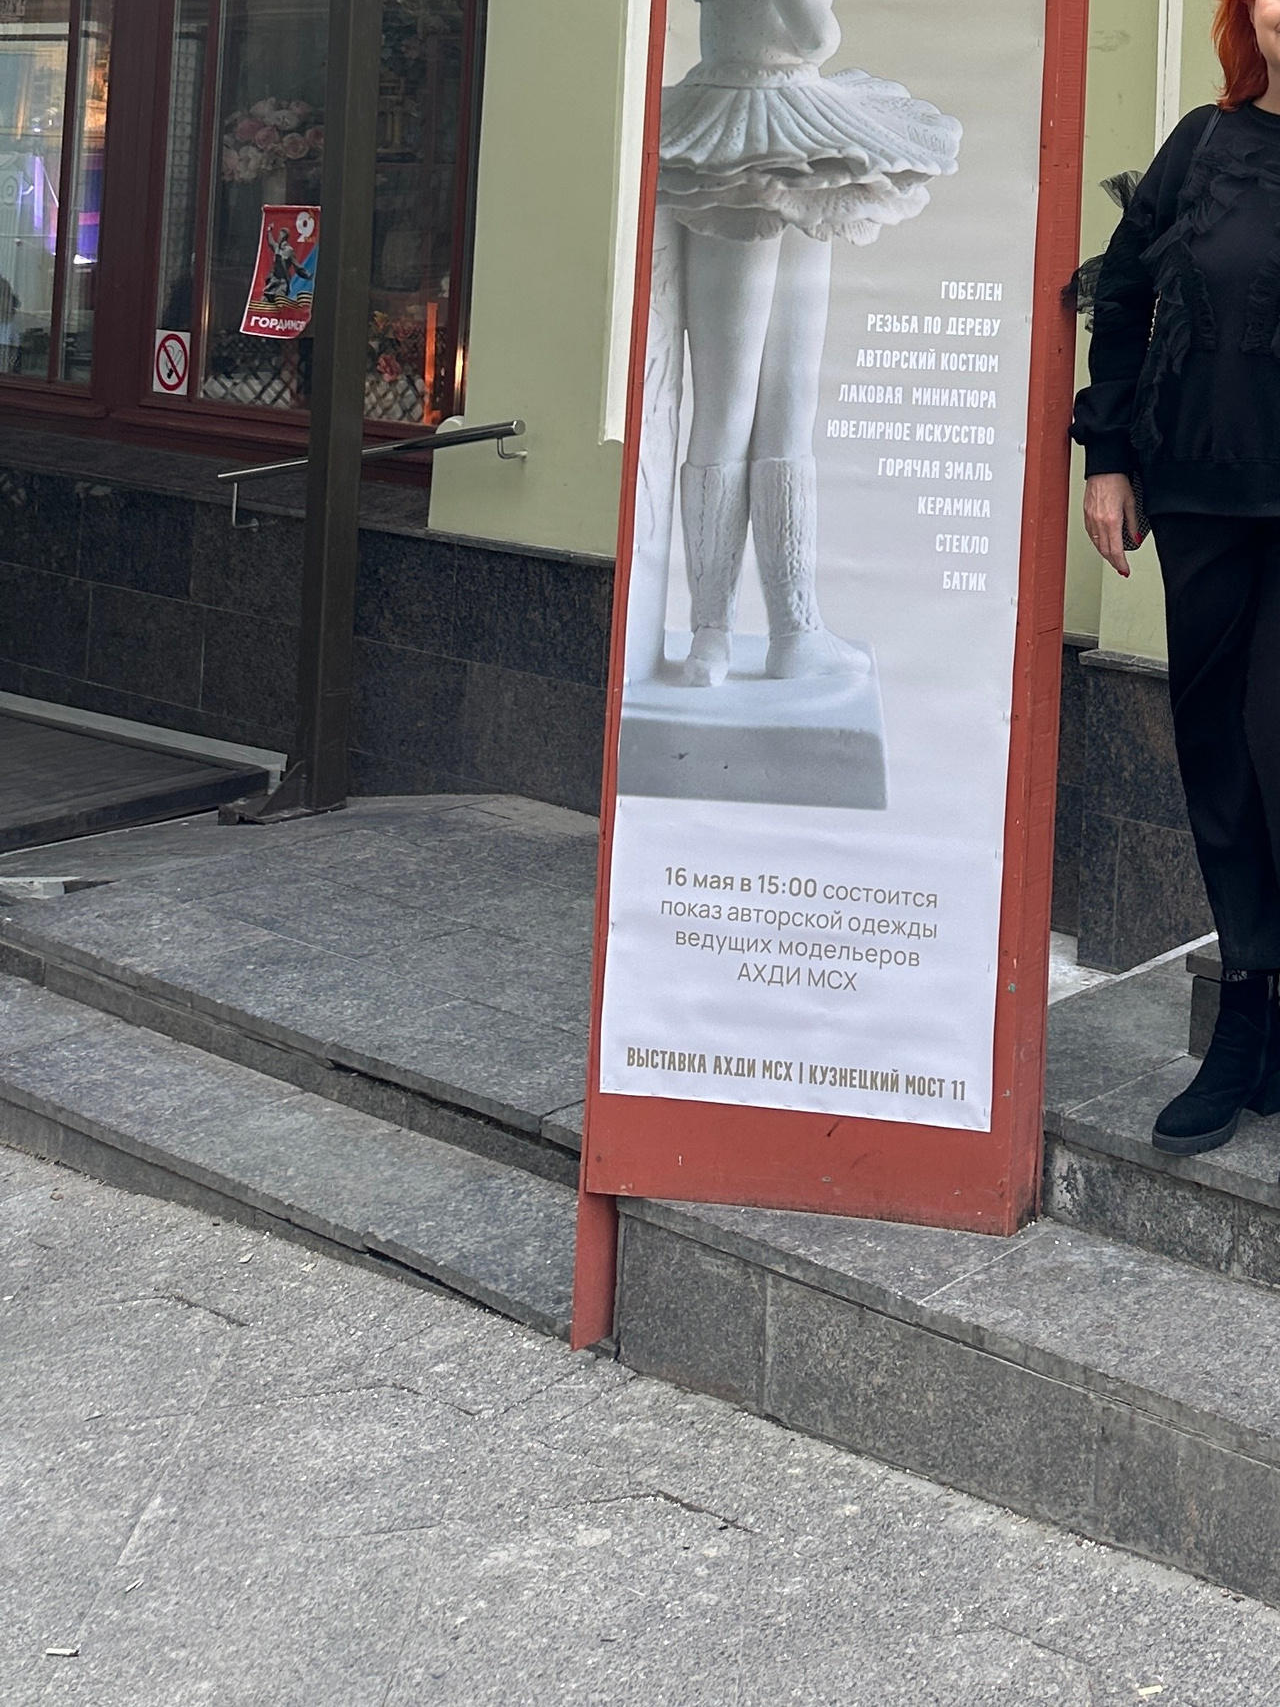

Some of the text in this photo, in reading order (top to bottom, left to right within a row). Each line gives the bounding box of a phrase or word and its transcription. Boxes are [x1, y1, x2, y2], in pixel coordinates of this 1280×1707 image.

[296, 211, 315, 242] 9
[941, 281, 1002, 301] ГОБЕЛЕН
[868, 314, 1001, 337] РЕЗЬБА ПО ДЕРЕВУ
[856, 349, 999, 373] АВТОРСКИЙ КОСТЮМ
[839, 384, 996, 408] ЛАКОВАЯ МИНИАТЮРА
[827, 419, 995, 445] ЮВЕЛИРНОЕ ИСКУССТВО
[878, 458, 993, 481] ГОРЯЧАЯ ЭМАЛЬ
[918, 496, 990, 518] КЕРАМИКА
[935, 534, 989, 555] СТЕКЛО
[943, 571, 986, 591] БАТИК
[664, 867, 938, 908] 16 мая в 15:00 состоится
[660, 901, 937, 939] показ авторской одежды
[675, 932, 920, 967] ведущих модельеров
[737, 963, 857, 991] АХДИ МСХ
[627, 1047, 707, 1074] ВЫСТАВКА
[713, 1056, 756, 1078] АХДИ
[762, 1060, 793, 1081] МСХ
[809, 1064, 899, 1093] КУЗНЕЦКИЙ
[905, 1076, 945, 1098] МОСТ
[951, 1080, 966, 1101] 11
